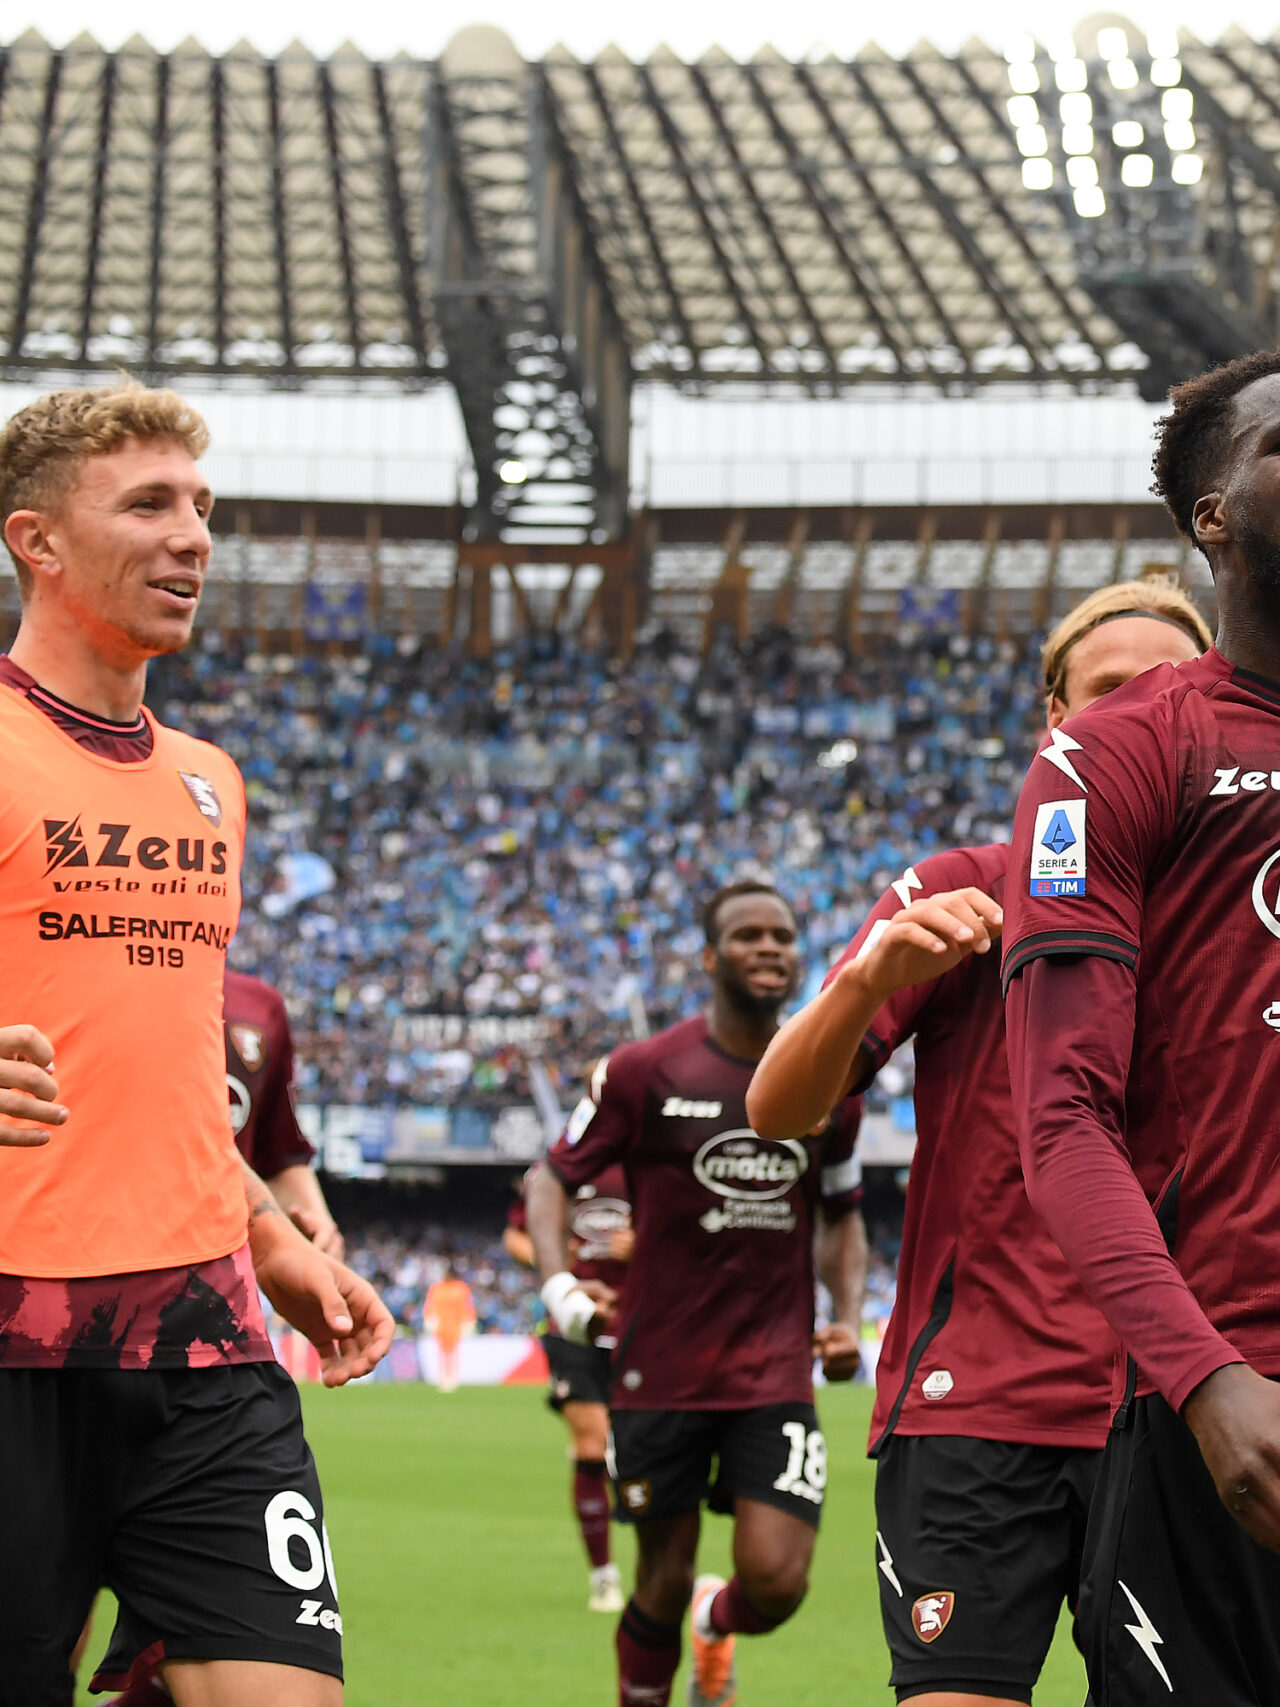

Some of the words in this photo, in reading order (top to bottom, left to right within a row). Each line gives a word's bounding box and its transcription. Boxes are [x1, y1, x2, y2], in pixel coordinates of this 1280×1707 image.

[95, 823, 228, 875] Zeus
[1038, 858, 1068, 868] SERIE
[1070, 858, 1078, 868] A
[52, 877, 140, 893] veste
[197, 881, 227, 897] dei
[1053, 881, 1078, 893] TIM
[126, 944, 184, 968] 1919
[782, 1422, 827, 1490] 18
[264, 1490, 339, 1601] 6
